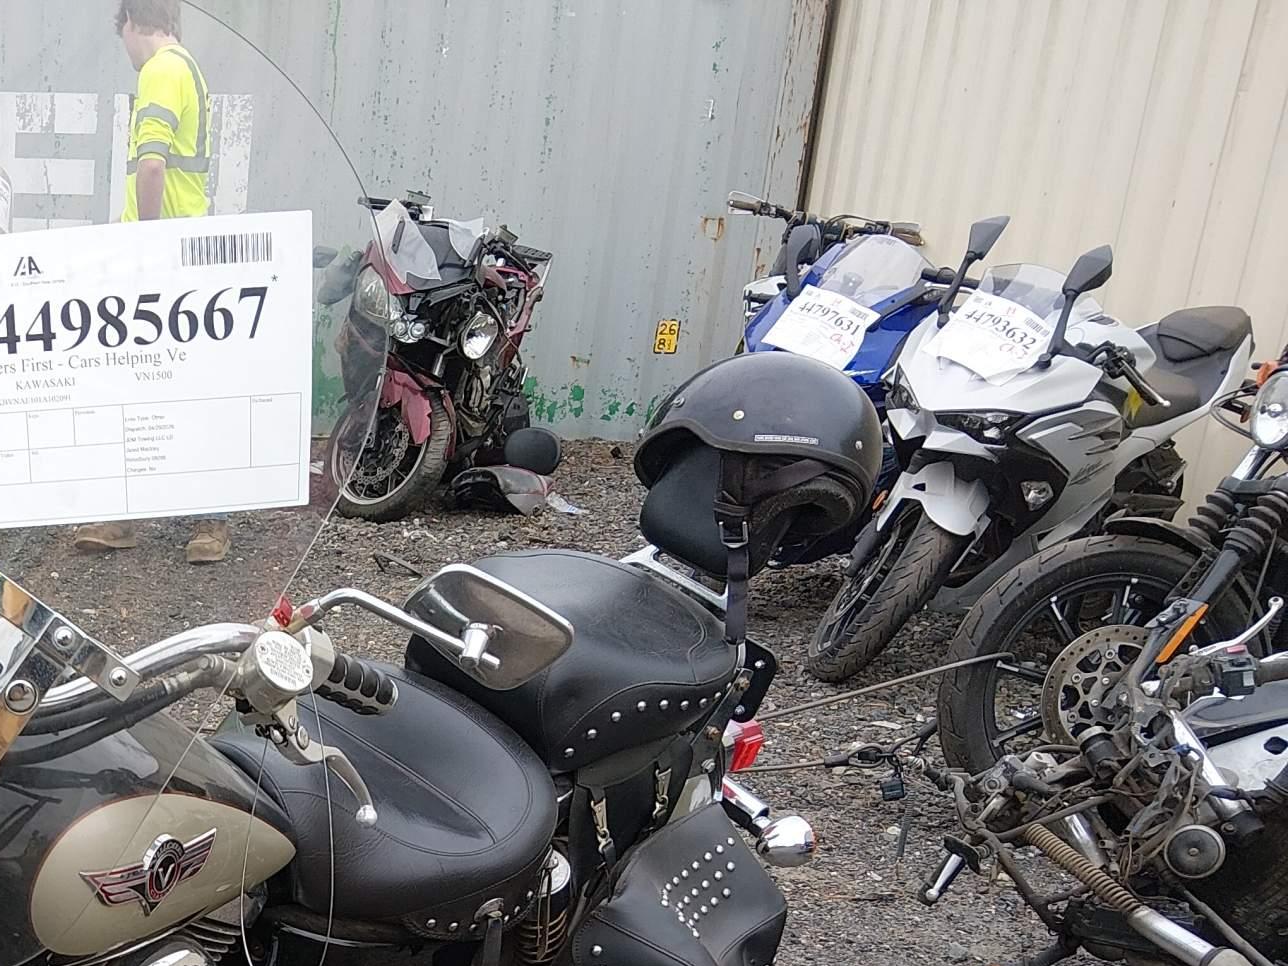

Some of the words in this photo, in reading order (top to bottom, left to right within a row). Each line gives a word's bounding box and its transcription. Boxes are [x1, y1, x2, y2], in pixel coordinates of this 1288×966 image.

[799, 301, 861, 335] 44797631
[964, 309, 1037, 350] 44793632
[21, 358, 54, 373] First
[68, 355, 101, 369] Cars
[105, 351, 162, 368] Helping
[166, 348, 187, 362] Ve
[15, 377, 76, 391] KAWASAKI
[134, 370, 173, 382] VN1500
